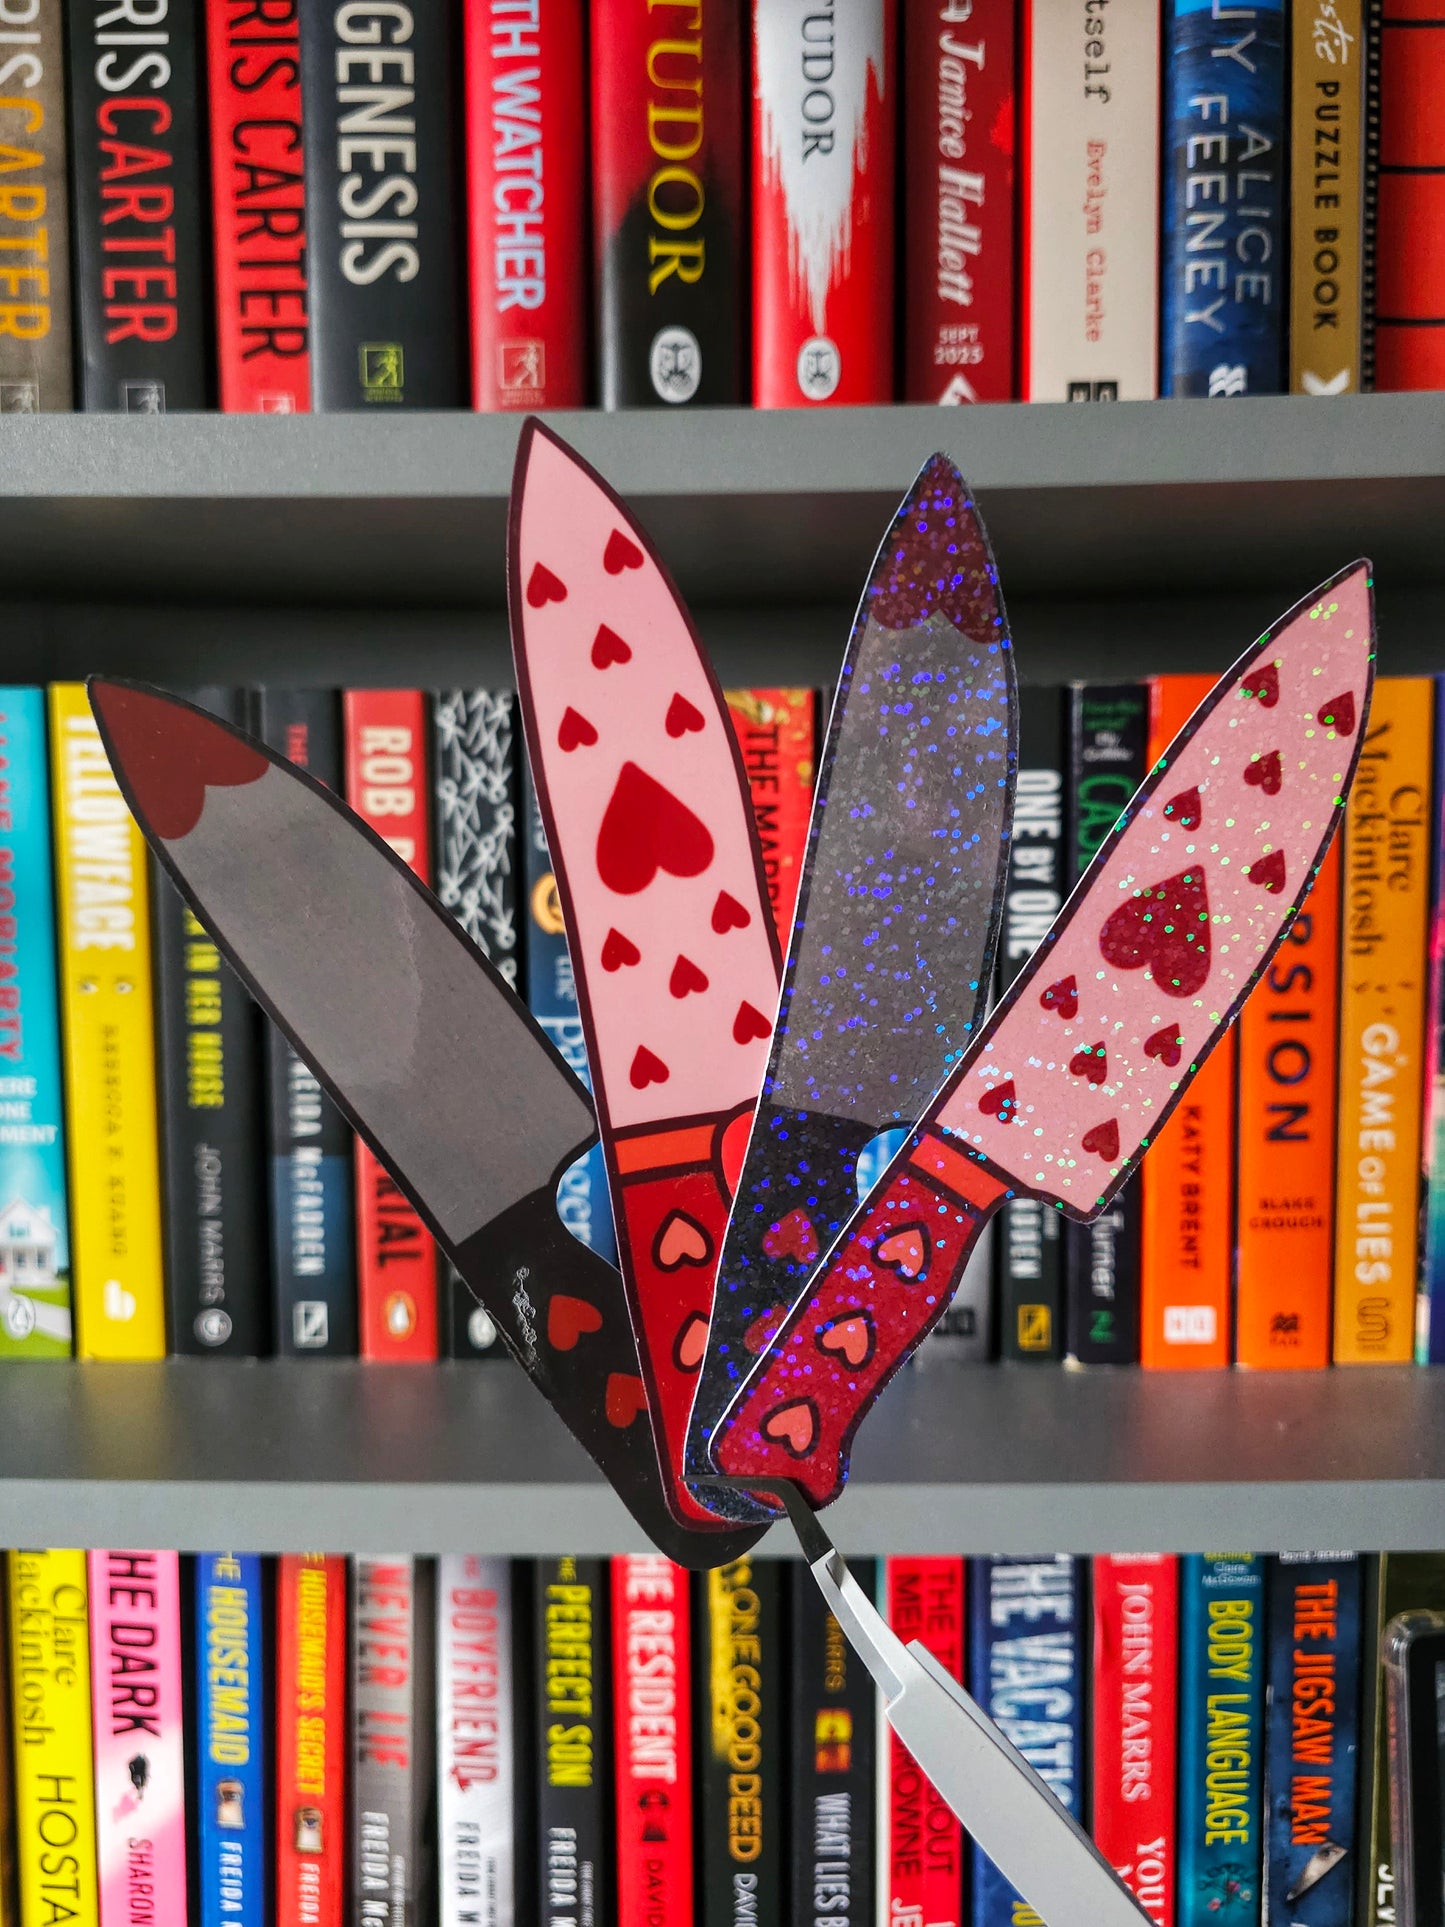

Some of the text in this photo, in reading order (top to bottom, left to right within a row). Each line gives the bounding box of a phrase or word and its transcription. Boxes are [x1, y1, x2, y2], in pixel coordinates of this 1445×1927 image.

[801, 0, 835, 163] UDOR
[939, 32, 985, 160] Janice
[334, 2, 420, 285] GENESIS
[492, 68, 546, 311] WATCHER
[1085, 140, 1107, 236] Evelyn
[1315, 82, 1341, 210] PUZZLE
[97, 97, 178, 344] CARTER
[232, 119, 310, 362] CARTER
[938, 166, 985, 306] Hallett
[1185, 96, 1228, 333] FEENEY
[1237, 126, 1272, 306] ALICE
[1085, 247, 1108, 342] Clarke
[1314, 229, 1340, 330] BOOK
[361, 726, 415, 817] ROB
[1012, 769, 1063, 841] ONE
[1012, 846, 1054, 884] BY
[1387, 784, 1423, 893] Clare
[1358, 1022, 1399, 1152] GAME
[194, 1142, 226, 1305] JOHN MARRS
[1092, 1209, 1125, 1301] Turner
[1355, 1202, 1393, 1285] LIES
[52, 1583, 86, 1689] Clare
[208, 1585, 251, 1767] HOUSEMAID
[358, 1563, 410, 1689] NEVER
[546, 1584, 592, 1718] PERFECT
[730, 1587, 762, 1664] ONE
[1117, 1582, 1154, 1676] JOHN
[1207, 1599, 1254, 1683] BODY
[110, 1622, 162, 1738] DARK
[450, 1587, 499, 1784] BOYFRIEND
[627, 1609, 678, 1784] RESIDENT
[729, 1665, 762, 1771] GOOD
[1290, 1578, 1339, 1847] THE JIGSAW MAN
[295, 1716, 326, 1797] SECRET
[547, 1723, 593, 1787] SON
[1120, 1682, 1154, 1804] MARRS
[1204, 1693, 1252, 1847] LANGUAGE
[360, 1811, 389, 1890] FREIDA
[456, 1821, 482, 1898] FREIDA
[549, 1827, 577, 1906] FREIDA
[728, 1773, 763, 1862] DEED
[814, 1792, 851, 1856] WHAT
[128, 1837, 156, 1925] SHARON
[218, 1841, 244, 1913] FREIDA
[298, 1862, 321, 1924] FREIDA
[813, 1862, 851, 1913] LIES
